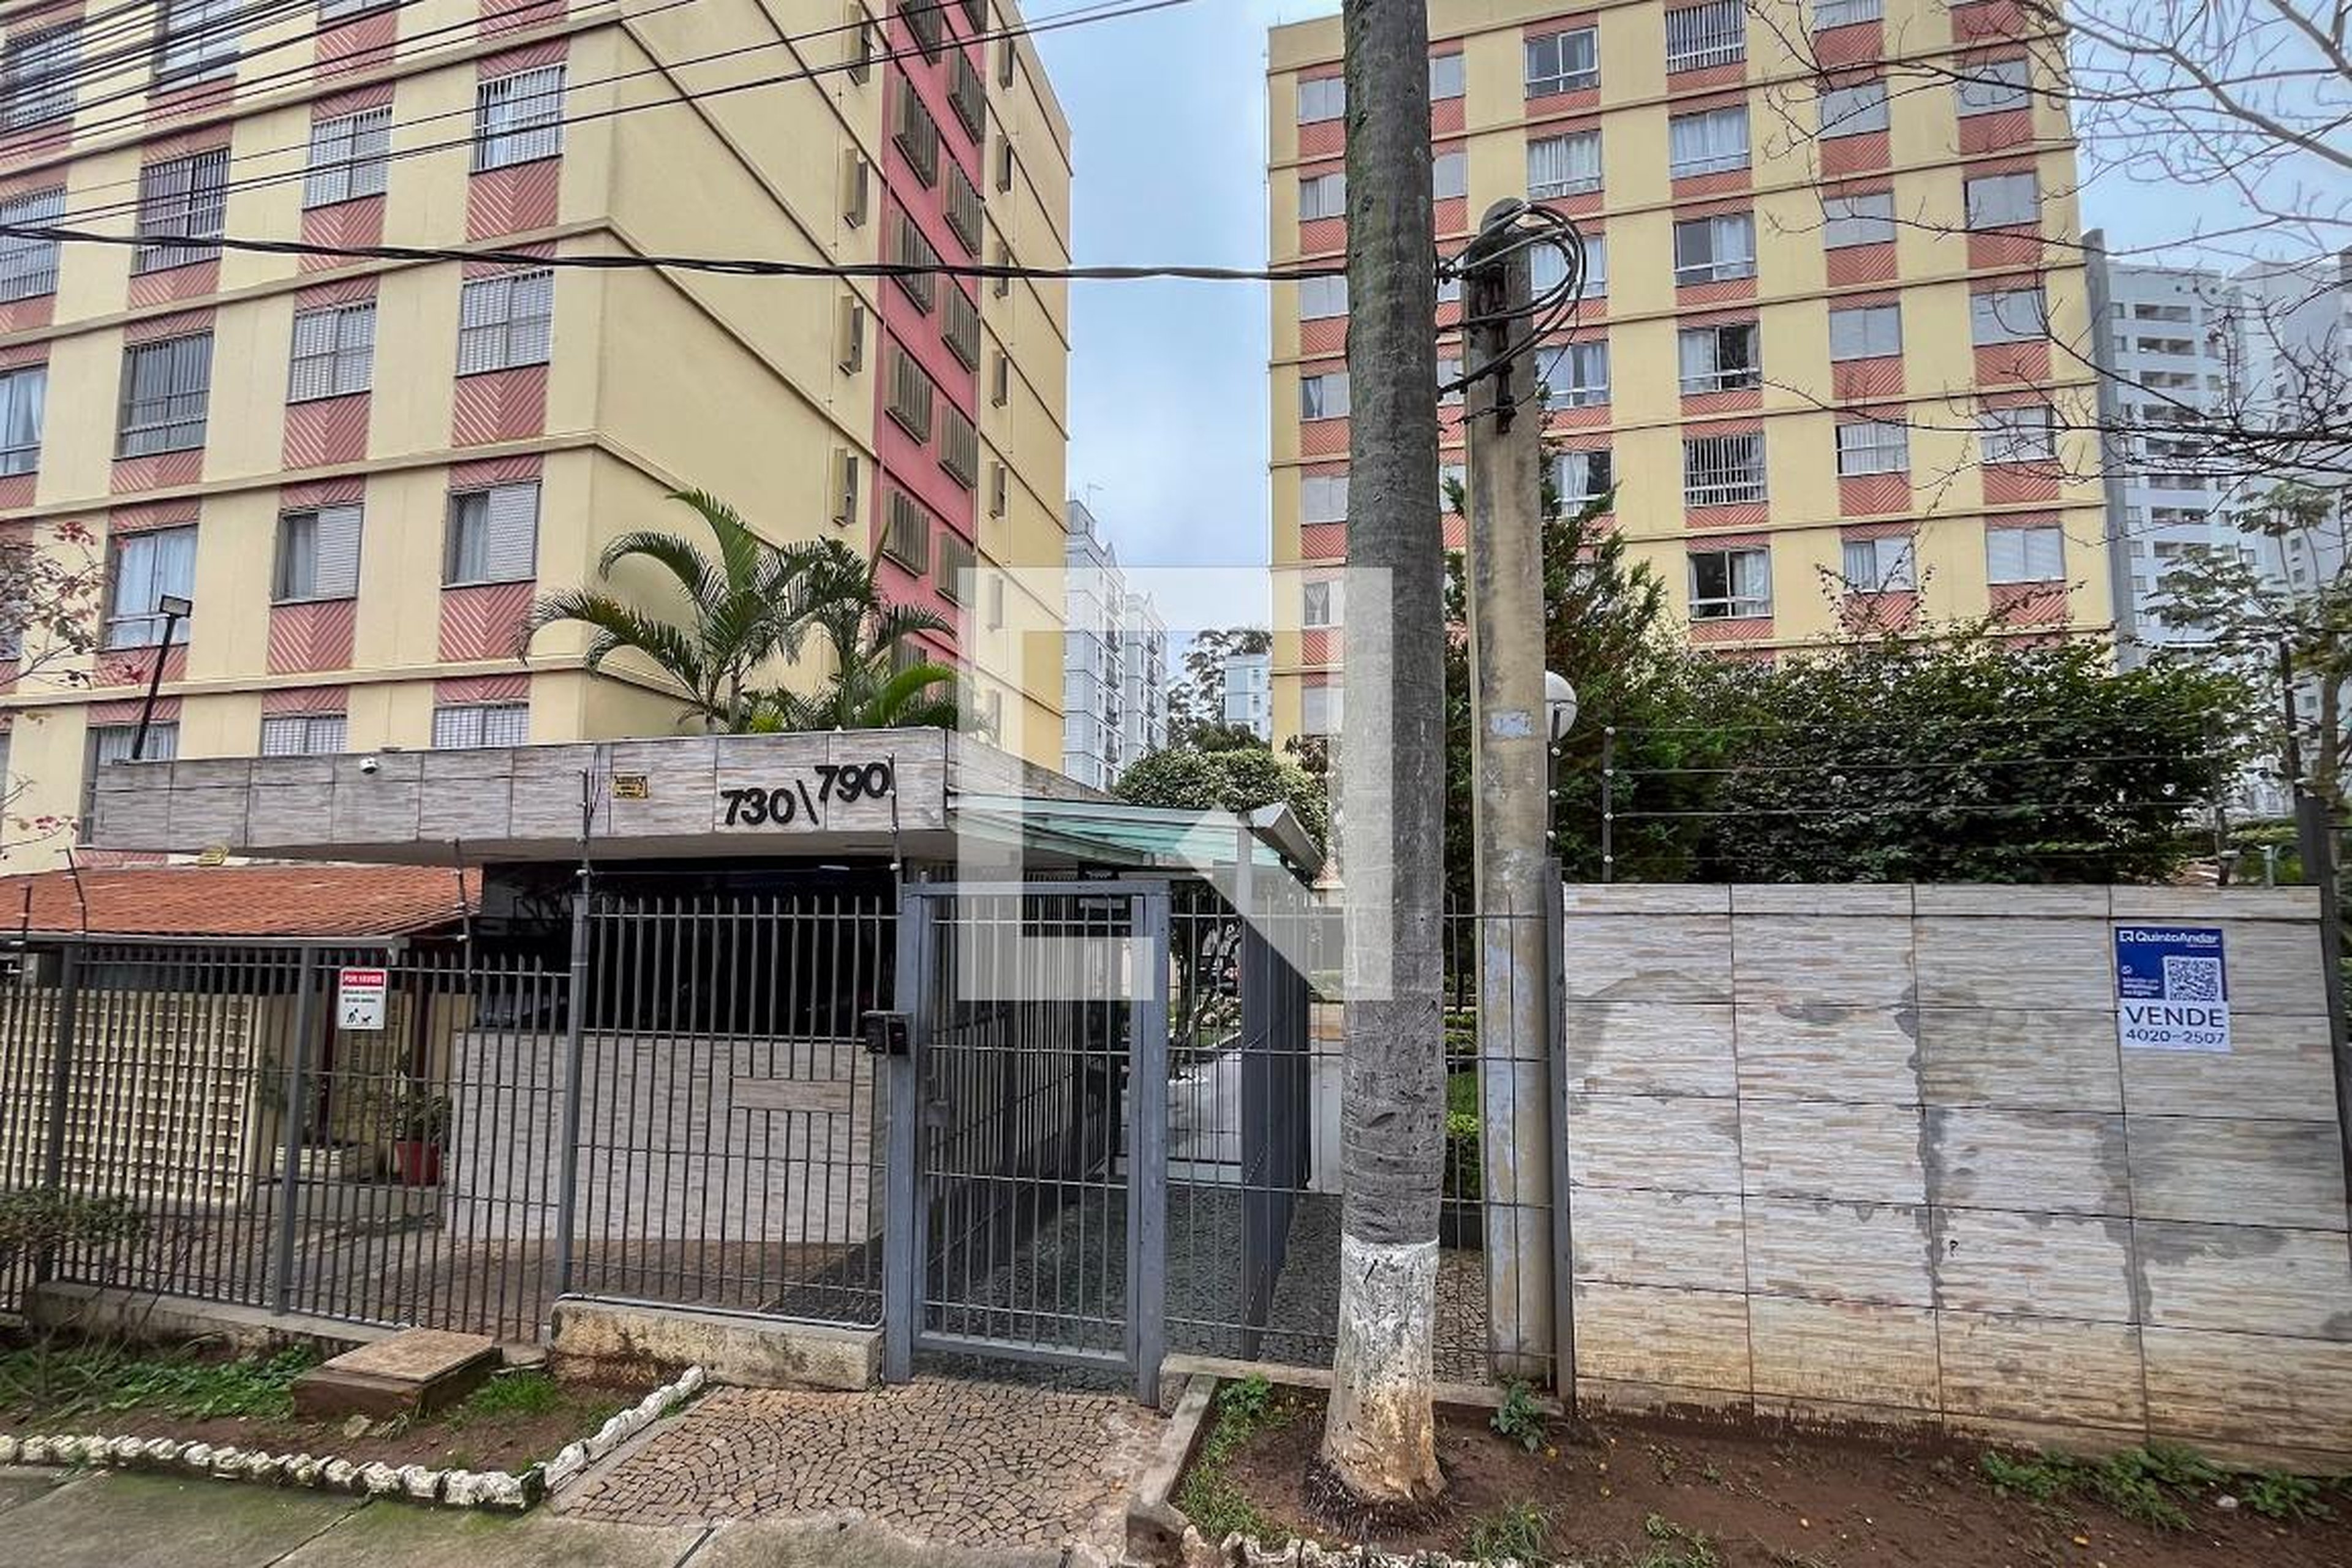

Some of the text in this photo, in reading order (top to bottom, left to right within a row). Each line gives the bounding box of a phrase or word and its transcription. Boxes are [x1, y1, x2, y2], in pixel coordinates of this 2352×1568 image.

[2135, 930, 2219, 944] QuintoAndar
[2125, 1006, 2225, 1028] VENDE
[2126, 1028, 2225, 1044] 4020-2507
